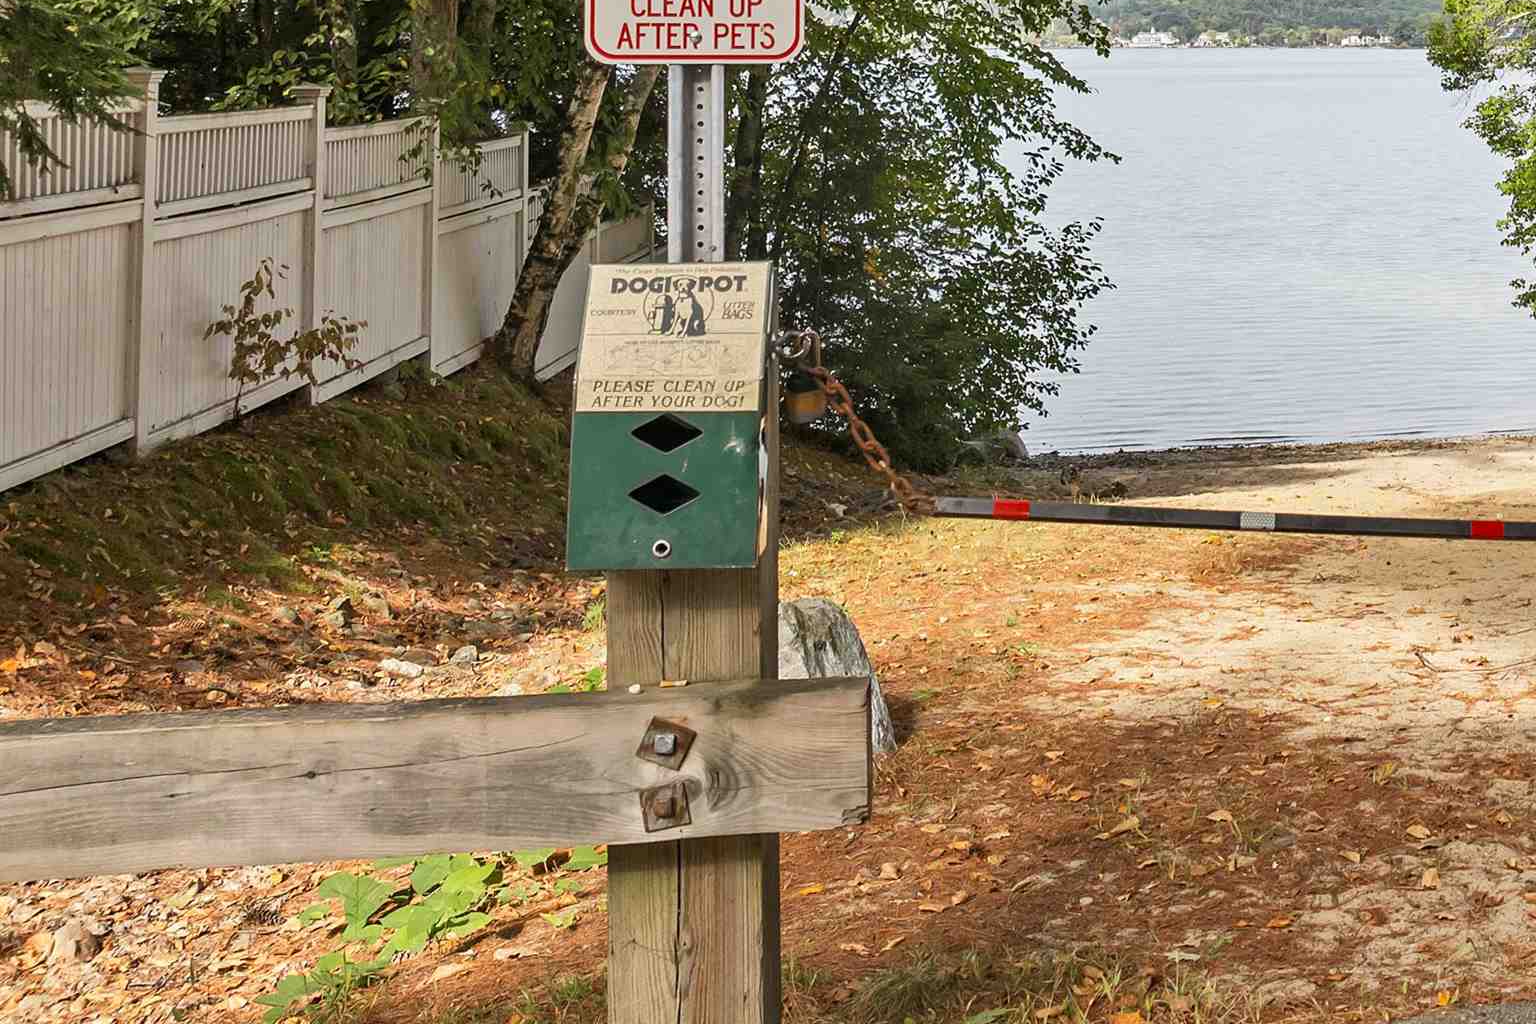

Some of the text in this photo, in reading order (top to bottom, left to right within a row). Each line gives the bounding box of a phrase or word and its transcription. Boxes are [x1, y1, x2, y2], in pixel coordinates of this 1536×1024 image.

[617, 23, 775, 50] AFTER PETS
[721, 309, 753, 320] BAGS
[592, 380, 745, 393] PLEASE CLEAN UP
[591, 395, 745, 408] AFTER YOUR DOG!
